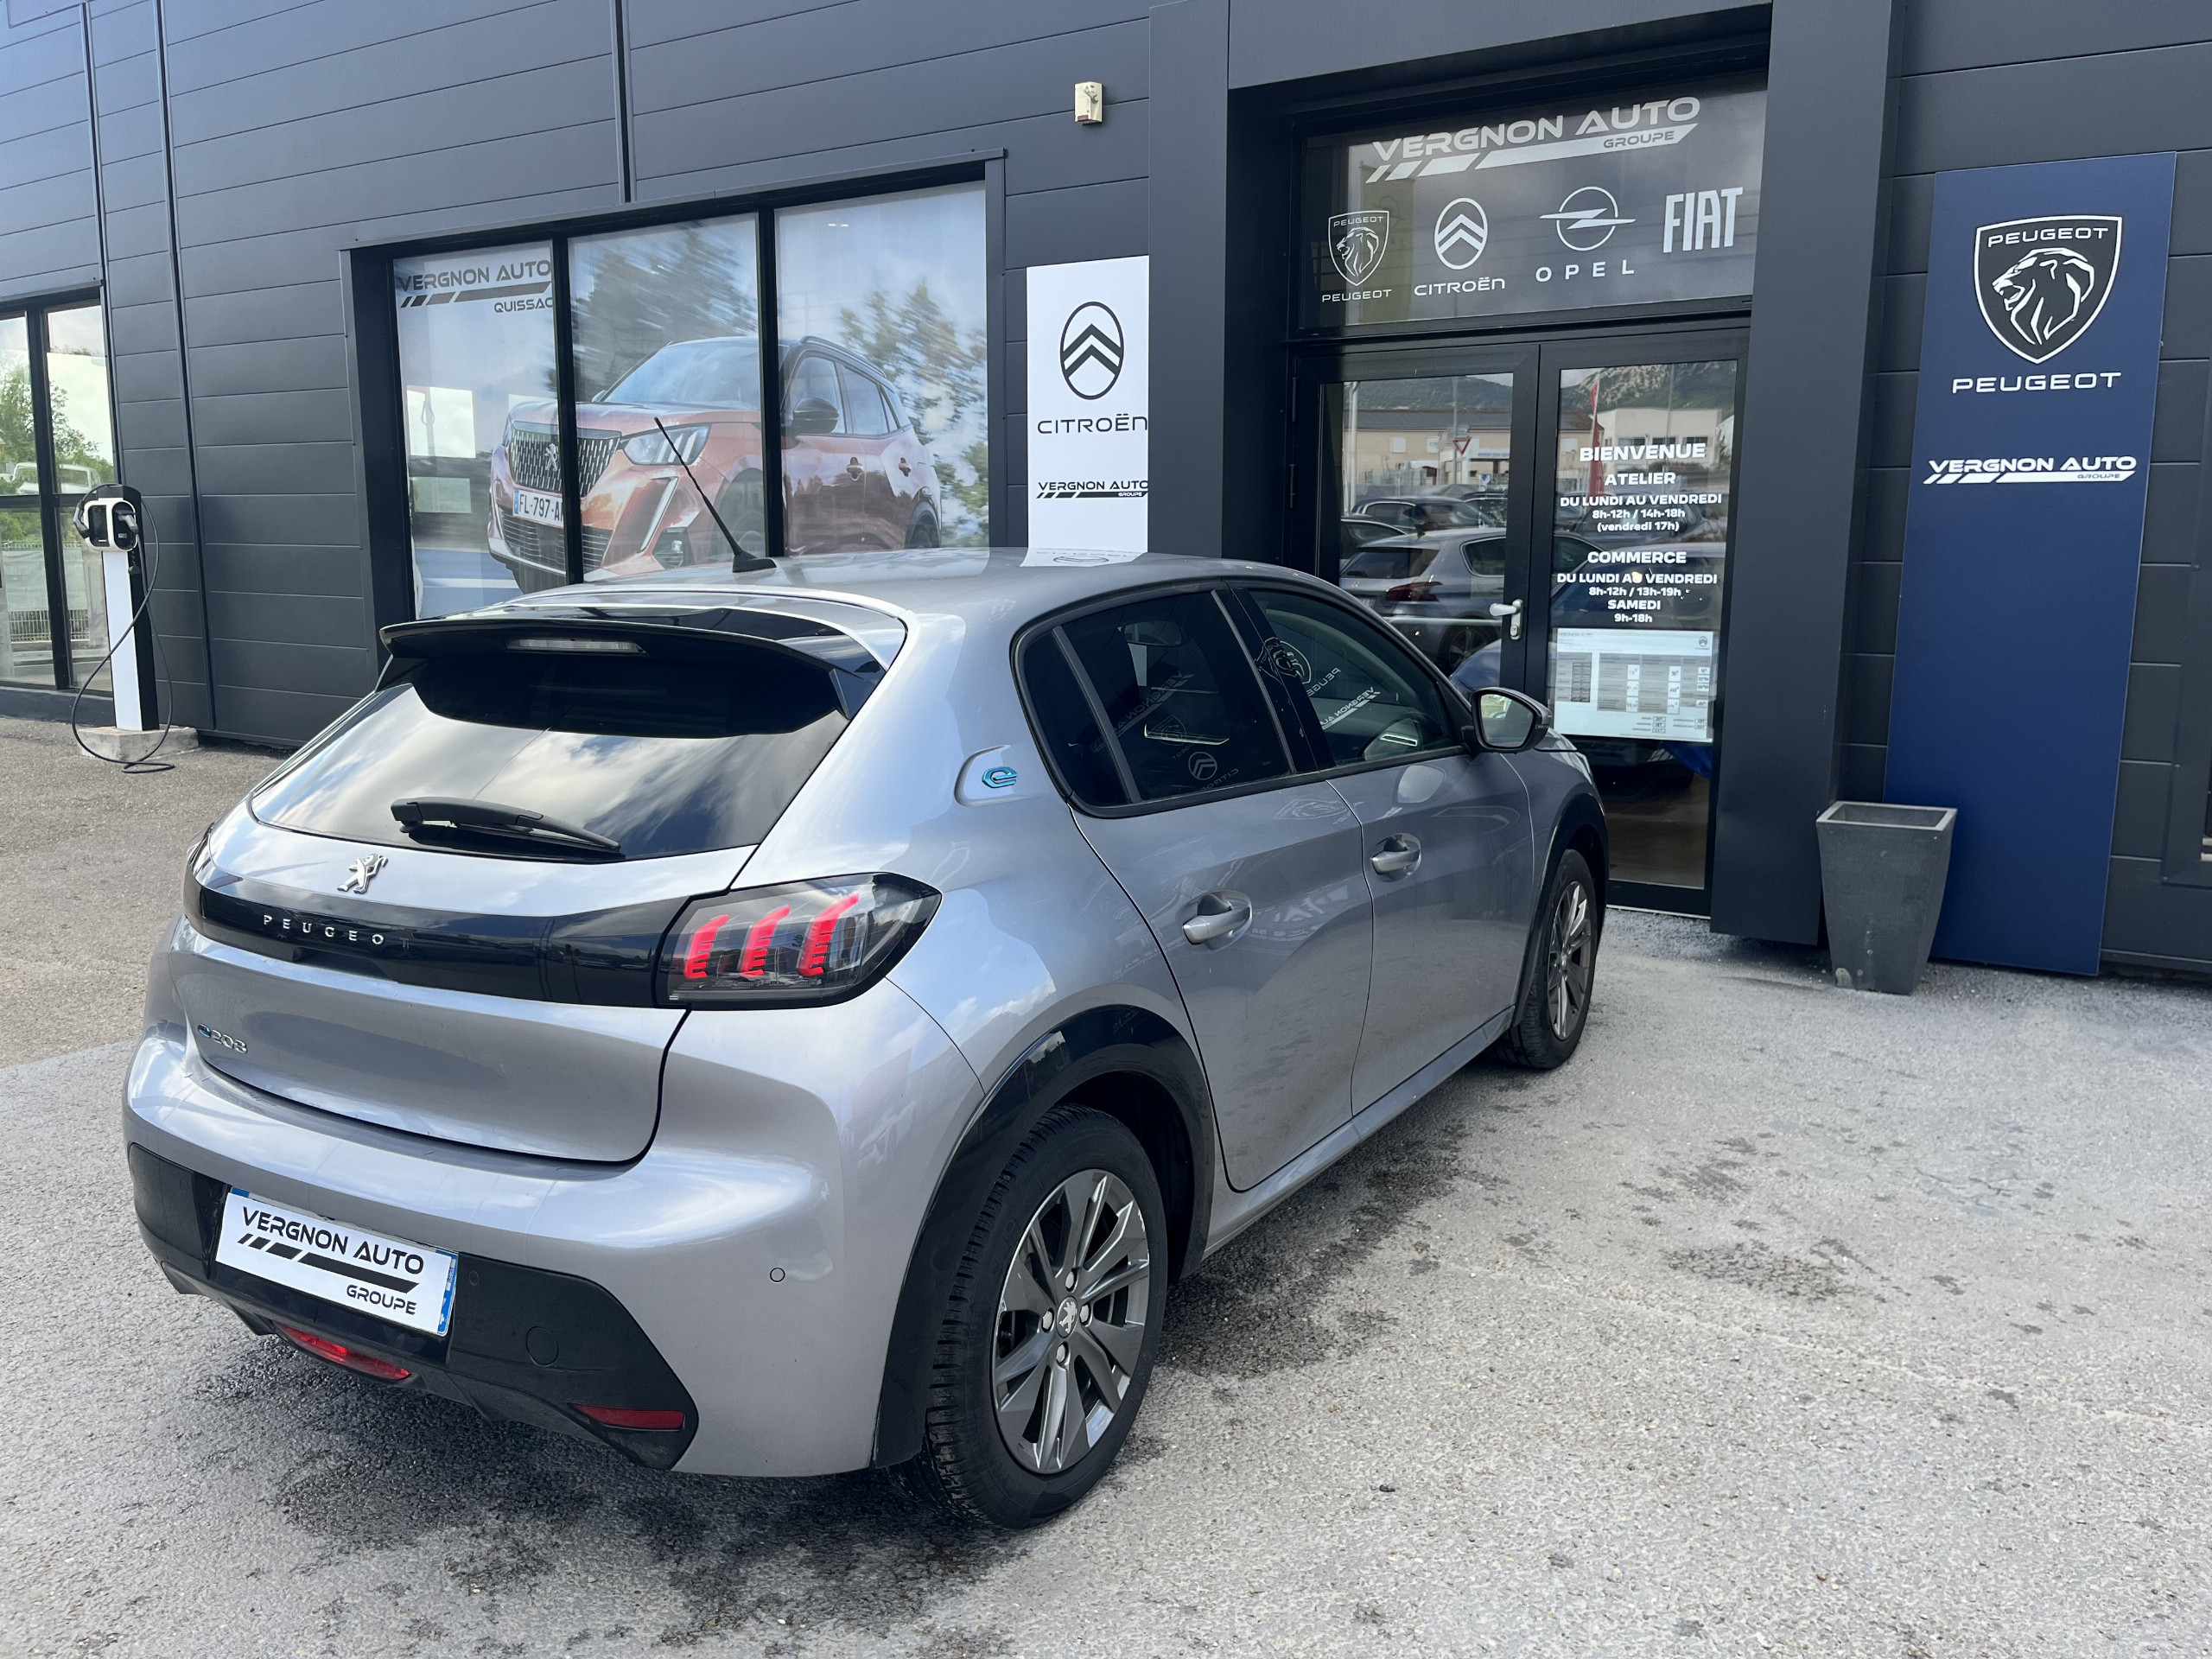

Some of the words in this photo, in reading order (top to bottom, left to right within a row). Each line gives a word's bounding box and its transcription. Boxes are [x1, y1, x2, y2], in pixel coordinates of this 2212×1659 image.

[1372, 115, 1563, 161] VERGNON
[1575, 96, 1701, 135] AUTO
[1603, 130, 1675, 149] GROUPE
[1333, 215, 1384, 228] PEUGEOT
[1662, 187, 1743, 253] FIAT
[1987, 227, 2108, 248] PEUGEOT
[397, 266, 490, 292] VERGNON
[496, 259, 552, 282] AUTO
[1535, 261, 1635, 283] OPEL
[1321, 289, 1392, 302] PEUGEOT
[493, 296, 554, 314] QUISSAC
[1952, 372, 2122, 394] PEUGEOT
[1580, 443, 1707, 461] BIENVENUE
[1928, 457, 2054, 474] VERGNON
[2059, 455, 2138, 471] AUTO
[1038, 480, 1106, 491] VERGNON
[1109, 480, 1149, 490] AUTO
[1605, 472, 1676, 486] ATELIER
[1560, 496, 1580, 507] DU
[1582, 495, 1623, 506] LUNDI
[1625, 494, 1646, 505] AU
[1649, 493, 1722, 505] VENDREDI
[1592, 509, 1630, 519] 8h-12h
[1641, 508, 1686, 518] 14h-18h
[1597, 522, 1652, 533] (vendredi
[1655, 521, 1680, 532] 17h)
[1587, 551, 1687, 564] COMMERCE
[1557, 573, 1576, 583] DU
[1579, 573, 1619, 583] LUNDI
[1645, 573, 1718, 584] VENDREDI
[1588, 586, 1627, 596] 8h-12h
[1637, 586, 1681, 597] 13h-19h
[1607, 600, 1661, 610] SAMEDI
[1614, 613, 1653, 623] 9h-18h
[243, 1206, 349, 1255] VERGNON
[353, 1241, 424, 1274] AUTO
[346, 1284, 417, 1316] GROUPE
